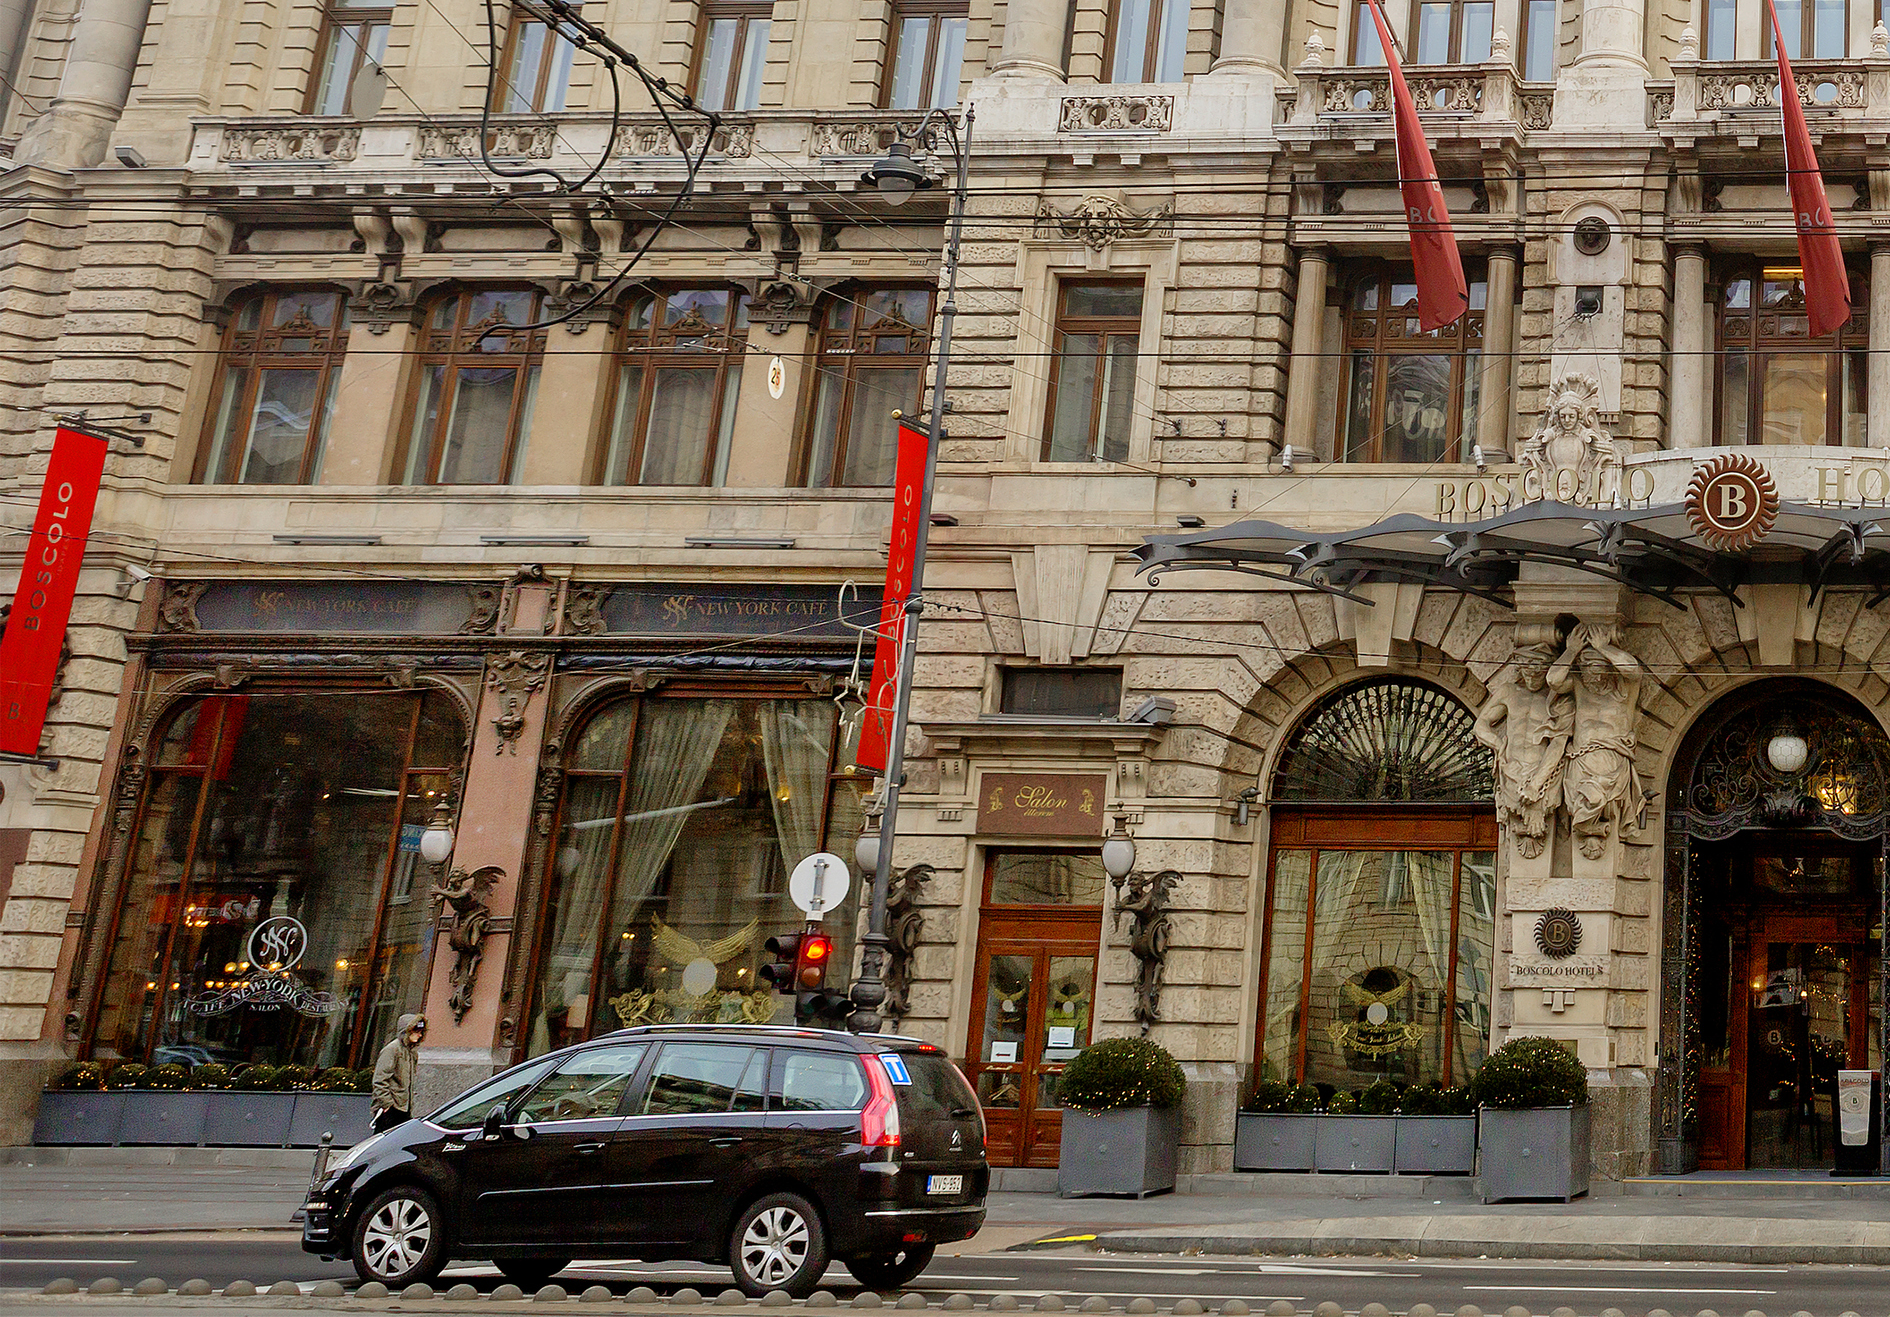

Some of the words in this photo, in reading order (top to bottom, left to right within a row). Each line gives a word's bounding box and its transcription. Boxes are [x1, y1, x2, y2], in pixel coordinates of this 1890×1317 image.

[1433, 467, 1655, 516] BOSCOLO
[1717, 484, 1747, 519] B
[24, 482, 73, 631] BOSCOLO
[697, 602, 732, 616] NEW
[735, 602, 781, 616] YORK
[1014, 785, 1068, 808] Salon
[1551, 923, 1566, 943] B
[1516, 966, 1563, 976] BOSCOLO
[1565, 965, 1604, 976] HOTELS
[883, 1056, 904, 1082] T
